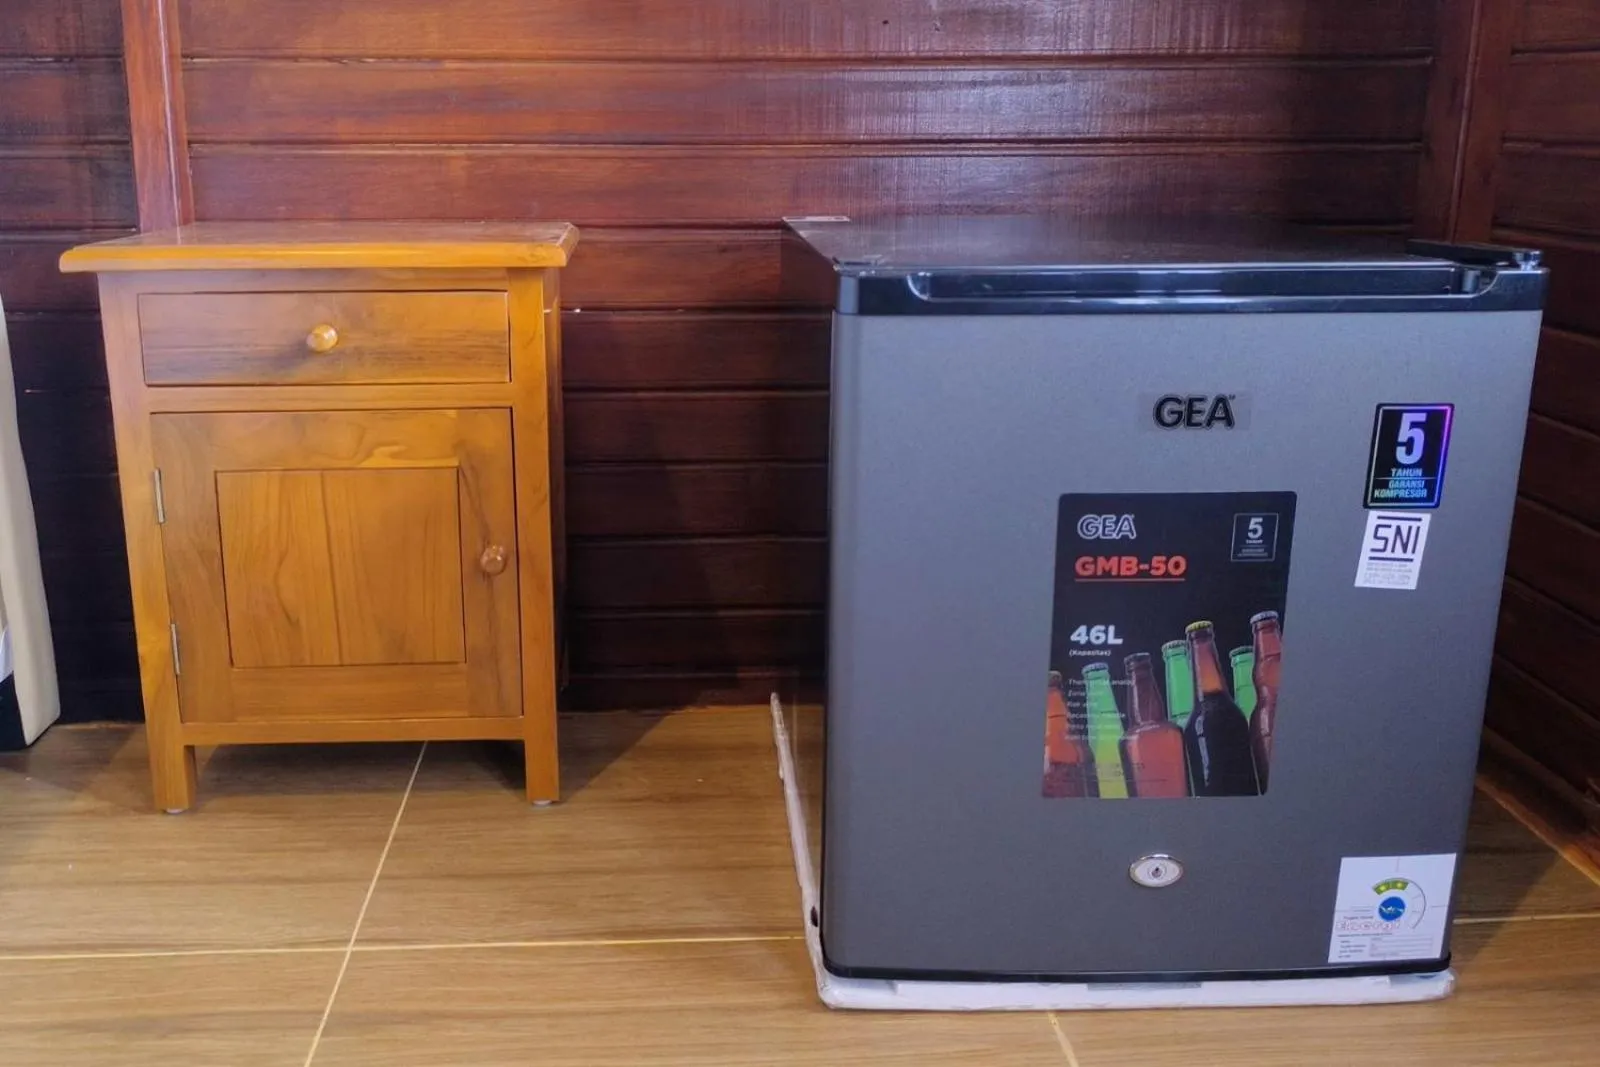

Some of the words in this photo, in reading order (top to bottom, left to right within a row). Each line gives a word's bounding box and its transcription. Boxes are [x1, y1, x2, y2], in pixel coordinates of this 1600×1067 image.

[1153, 394, 1235, 430] GEA
[1395, 412, 1427, 465] 5
[1390, 468, 1423, 477] TAHUN
[1374, 488, 1428, 499] KOMPRESOR
[1388, 479, 1425, 489] GARANSI
[1077, 514, 1137, 540] GEA
[1247, 517, 1263, 539] 5
[1370, 523, 1421, 555] SNI
[1074, 555, 1187, 577] GMB-50
[1070, 625, 1123, 645] 46L
